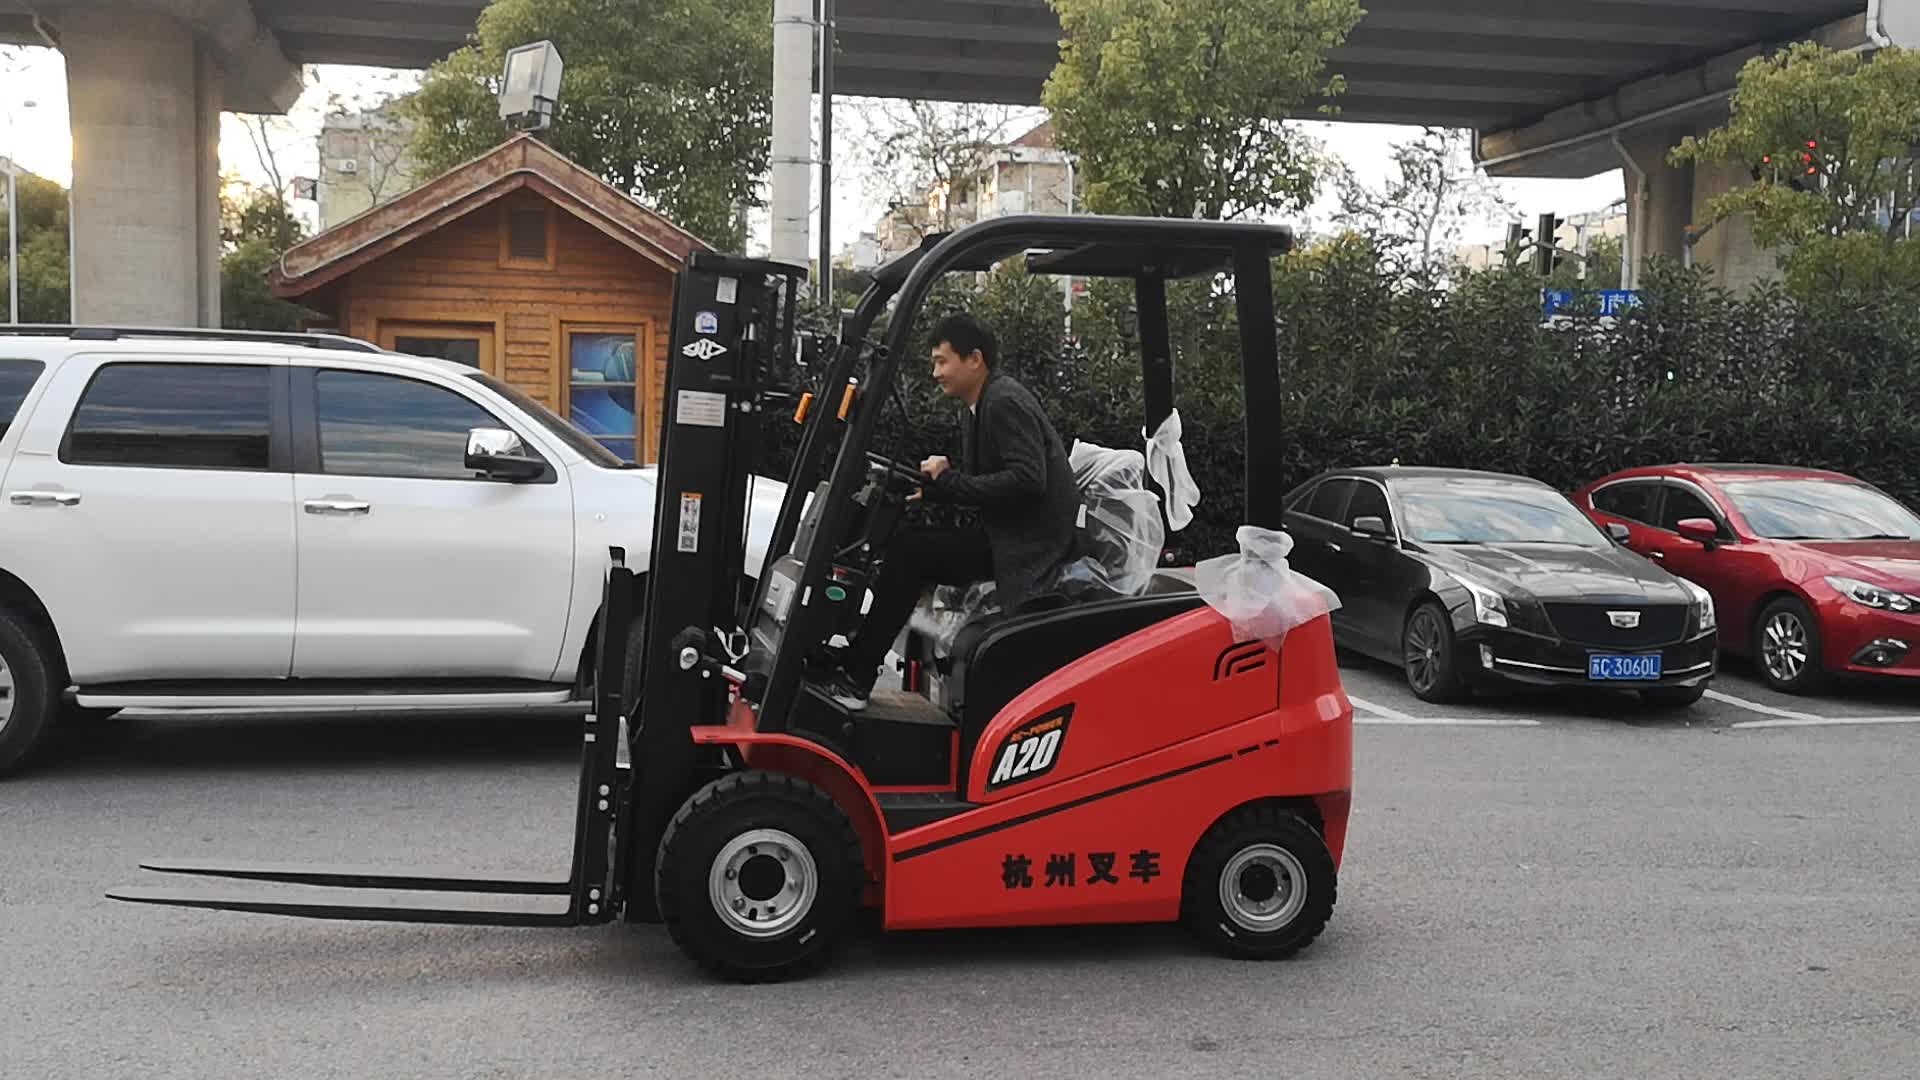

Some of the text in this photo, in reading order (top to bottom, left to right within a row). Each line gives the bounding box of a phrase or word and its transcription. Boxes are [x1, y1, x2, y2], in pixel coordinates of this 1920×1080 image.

[991, 729, 1062, 785] A20
[1002, 850, 1160, 888] 杭州叉车
